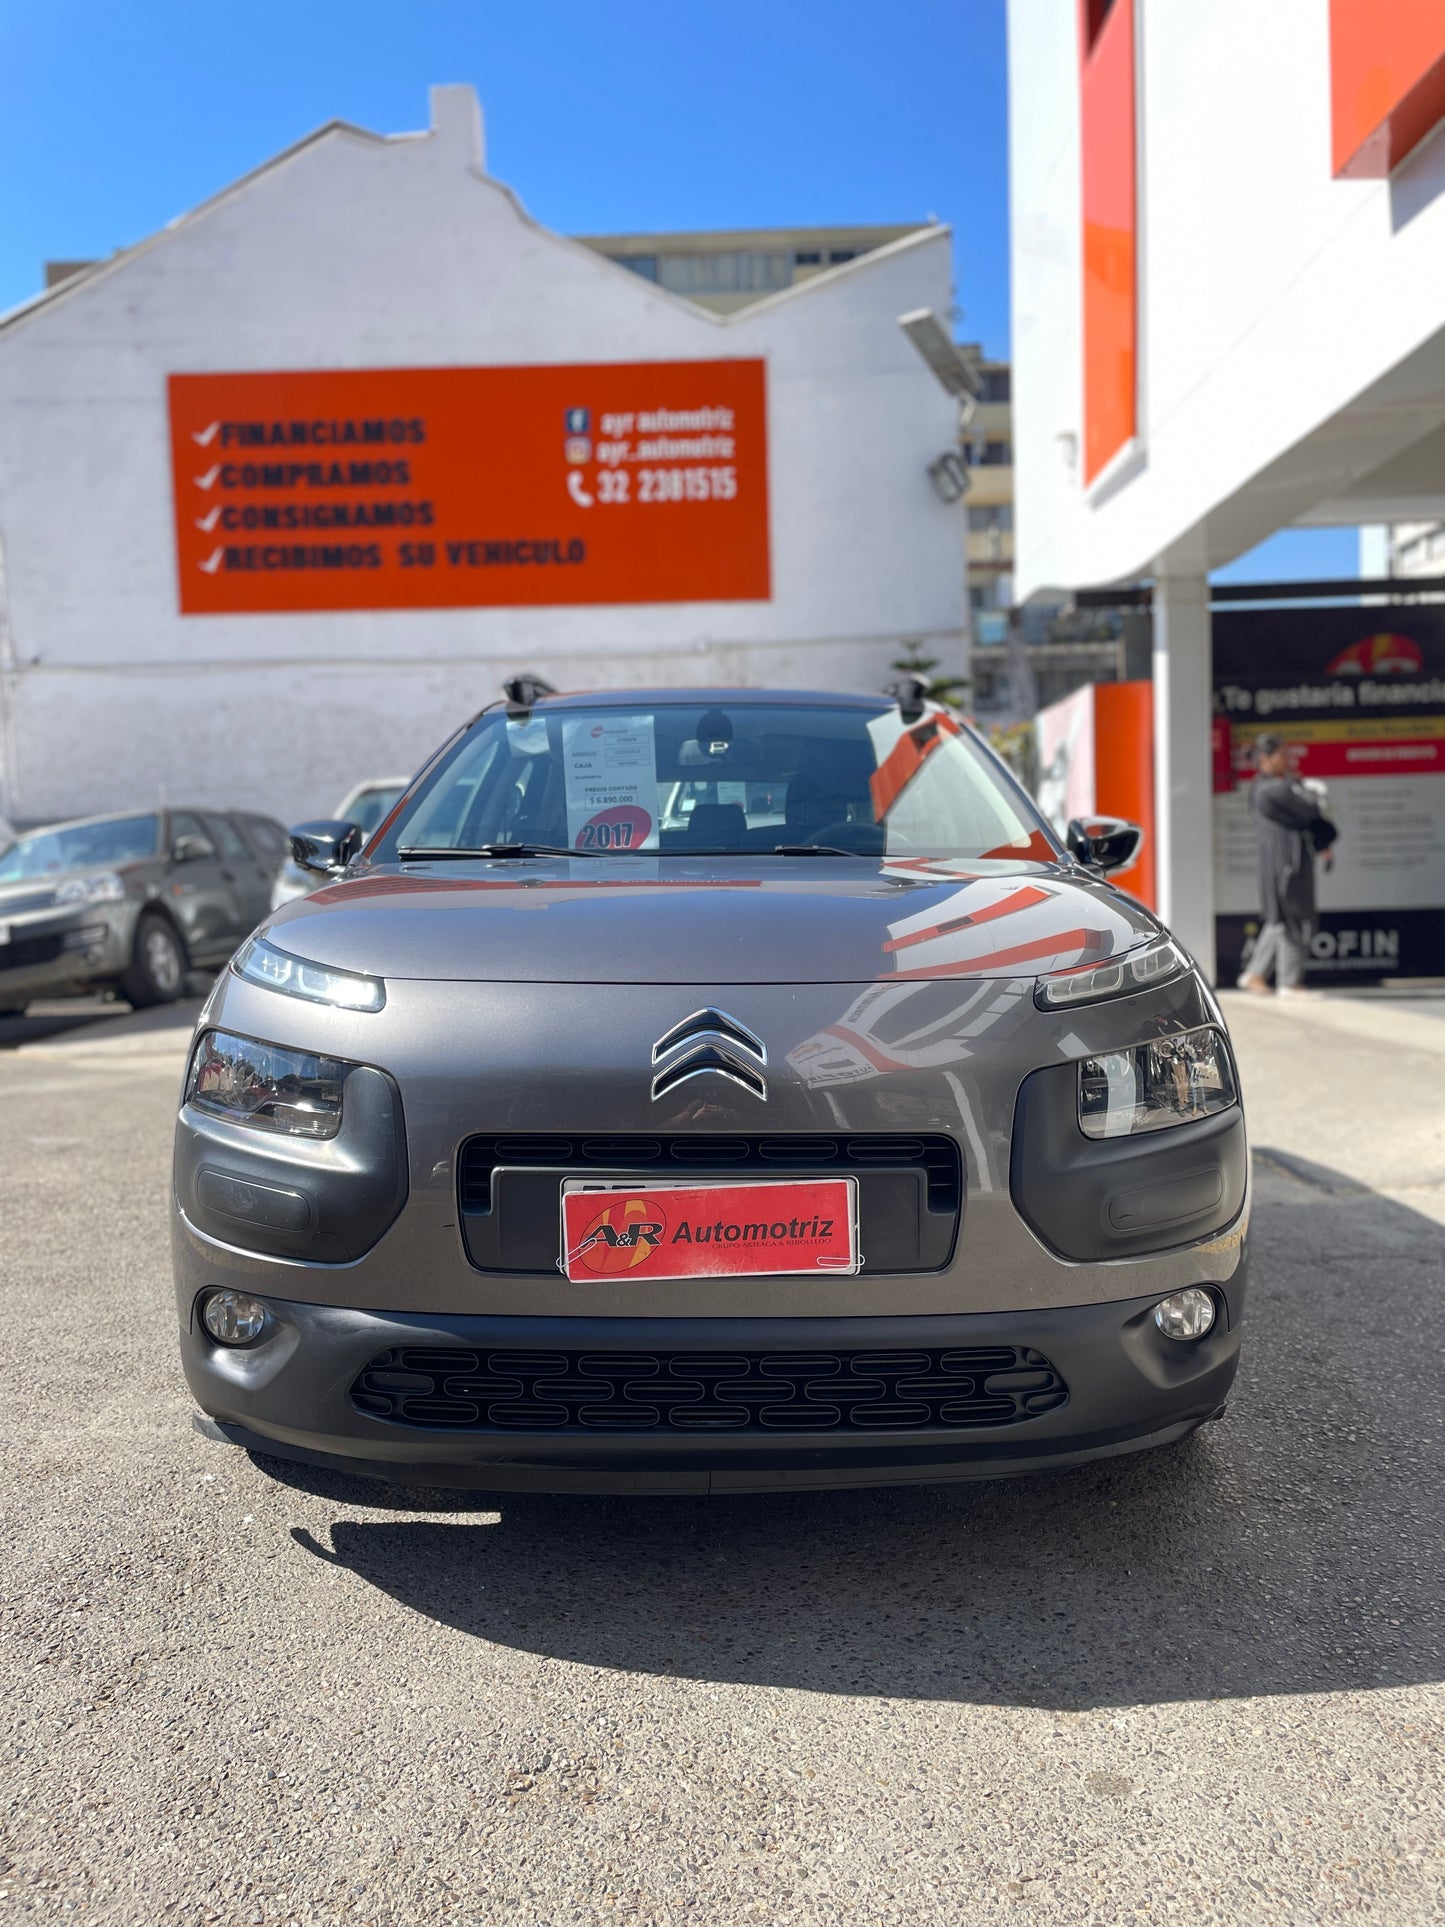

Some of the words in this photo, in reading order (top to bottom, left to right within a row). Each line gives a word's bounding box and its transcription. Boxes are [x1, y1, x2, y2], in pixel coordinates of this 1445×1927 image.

[220, 418, 426, 447] FINANCIAMOS
[637, 405, 735, 433] automotriz
[220, 460, 410, 489] COMPRAMOS
[597, 470, 630, 503] 32
[221, 501, 435, 531] CONSIGNAMOS
[224, 543, 382, 571] RECIBIMOS
[399, 542, 436, 568] SU
[446, 538, 587, 567] VEHICULO
[596, 795, 633, 804] 6.890.000
[582, 823, 633, 850] 2017
[580, 1222, 663, 1248] A&R
[671, 1215, 834, 1244] Automotriz
[742, 1240, 777, 1249] ARTEAGA
